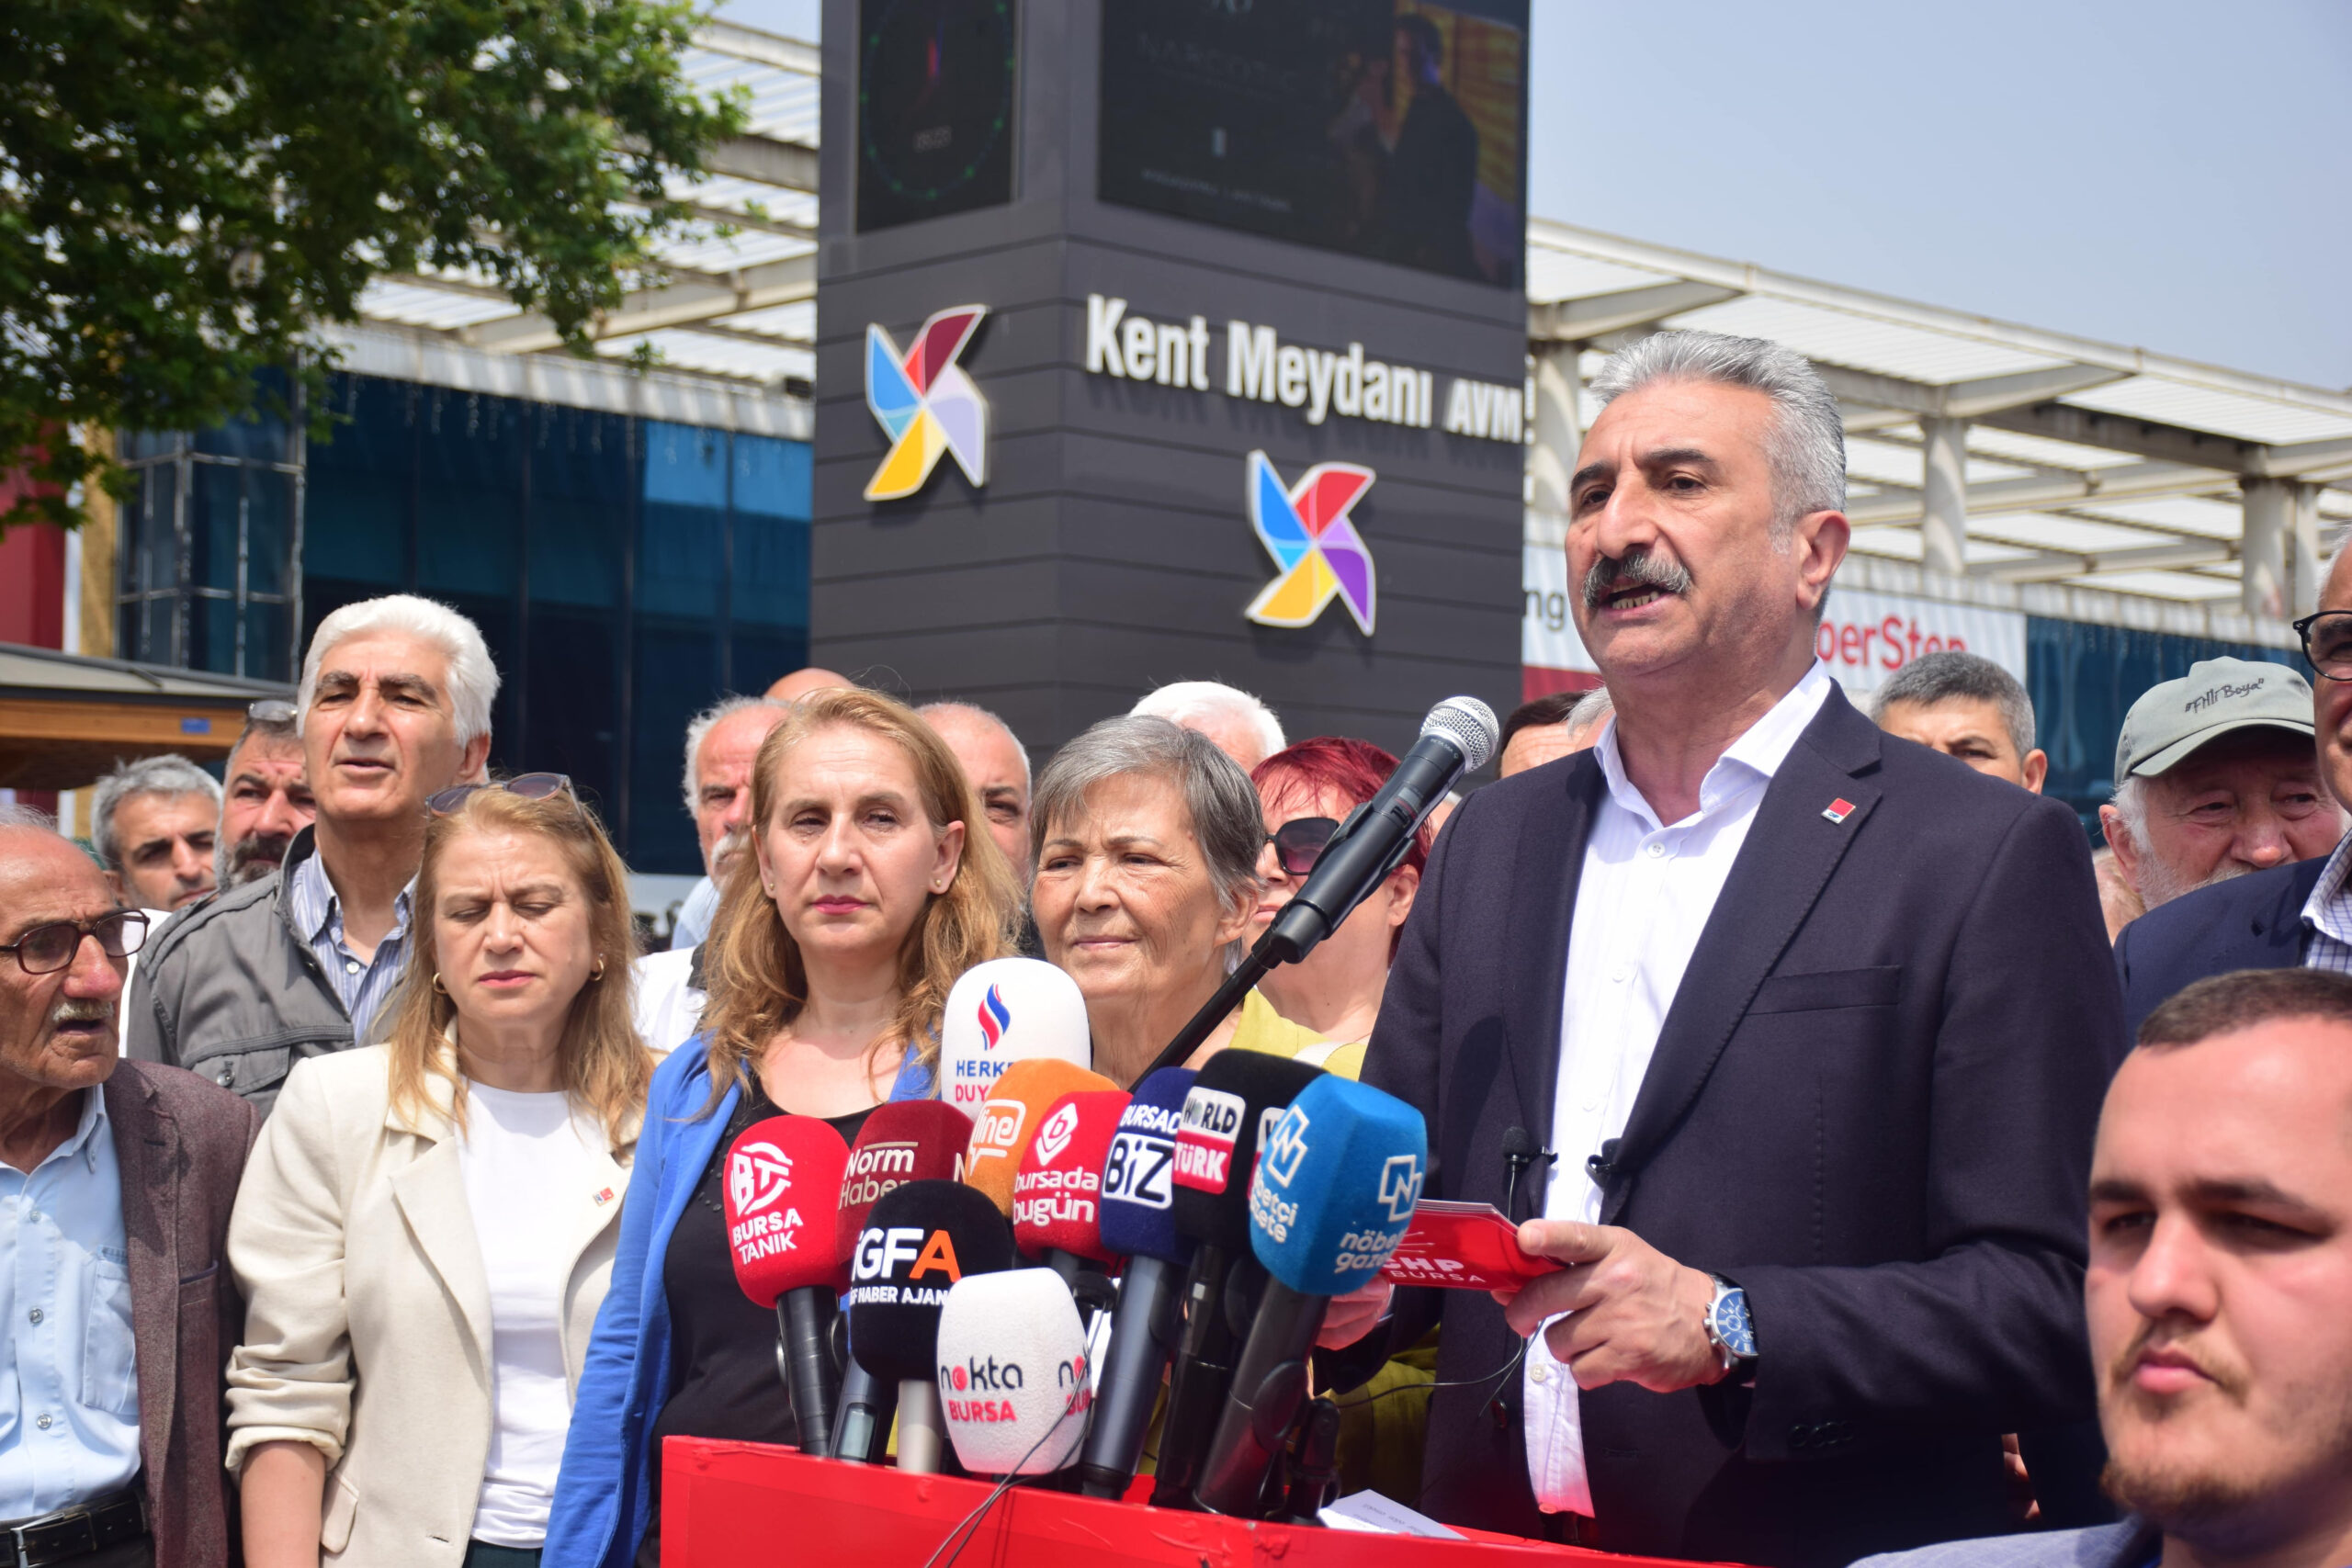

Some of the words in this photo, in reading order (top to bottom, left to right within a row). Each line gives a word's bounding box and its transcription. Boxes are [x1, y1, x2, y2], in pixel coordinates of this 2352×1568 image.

[1086, 293, 1210, 391] Kent
[1227, 320, 1433, 425] Meydanı
[1445, 378, 1524, 444] AVM
[843, 1147, 916, 1181] Norm
[1014, 1165, 1101, 1194] bursada
[1012, 1190, 1095, 1227] bugün
[732, 1208, 804, 1247] BURSA
[739, 1230, 798, 1265] TANIK
[1389, 1269, 1487, 1283] BURSA
[858, 1286, 899, 1304] HABER
[948, 1399, 1017, 1423] BURSA
